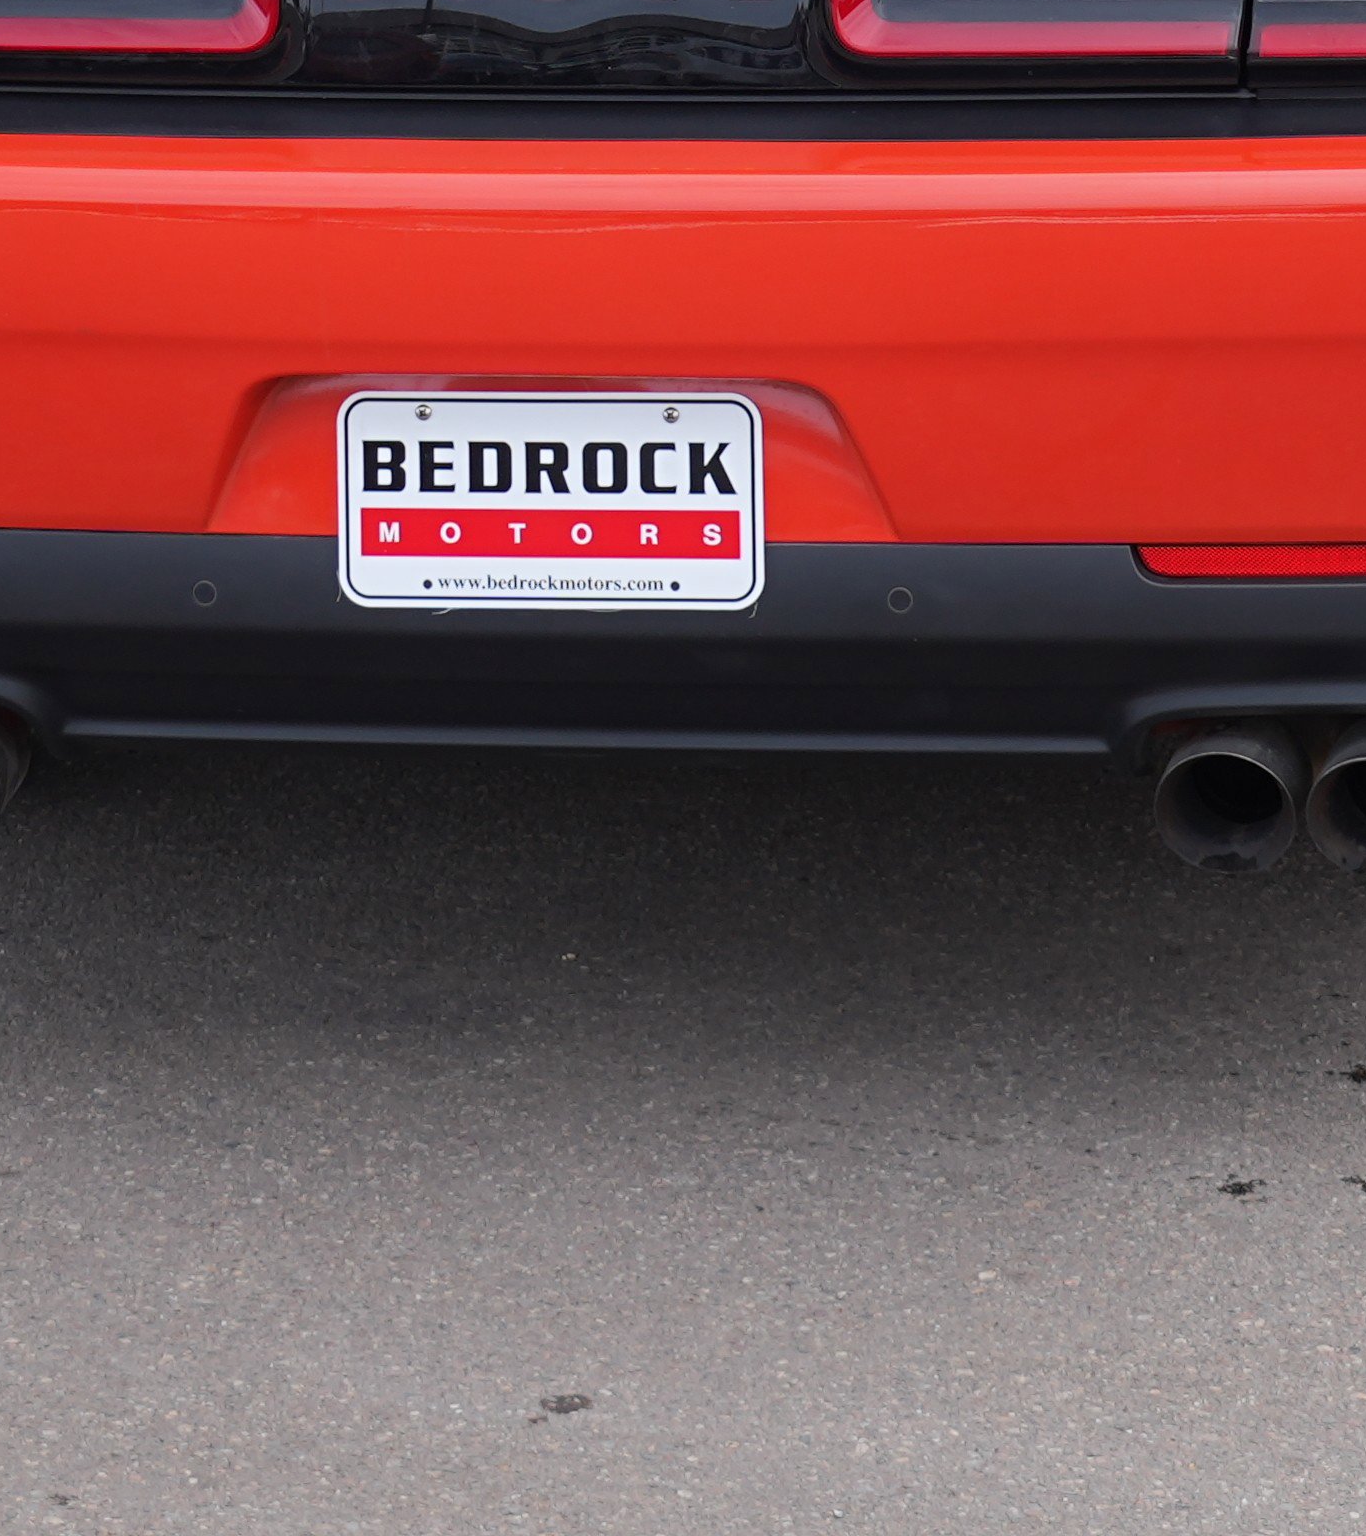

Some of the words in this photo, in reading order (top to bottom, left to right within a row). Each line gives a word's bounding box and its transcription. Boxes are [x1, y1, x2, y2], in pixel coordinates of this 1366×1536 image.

[362, 440, 738, 495] BEDROCK
[378, 521, 723, 546] MOTORS
[438, 574, 664, 592] www.bedrockmotors.com
